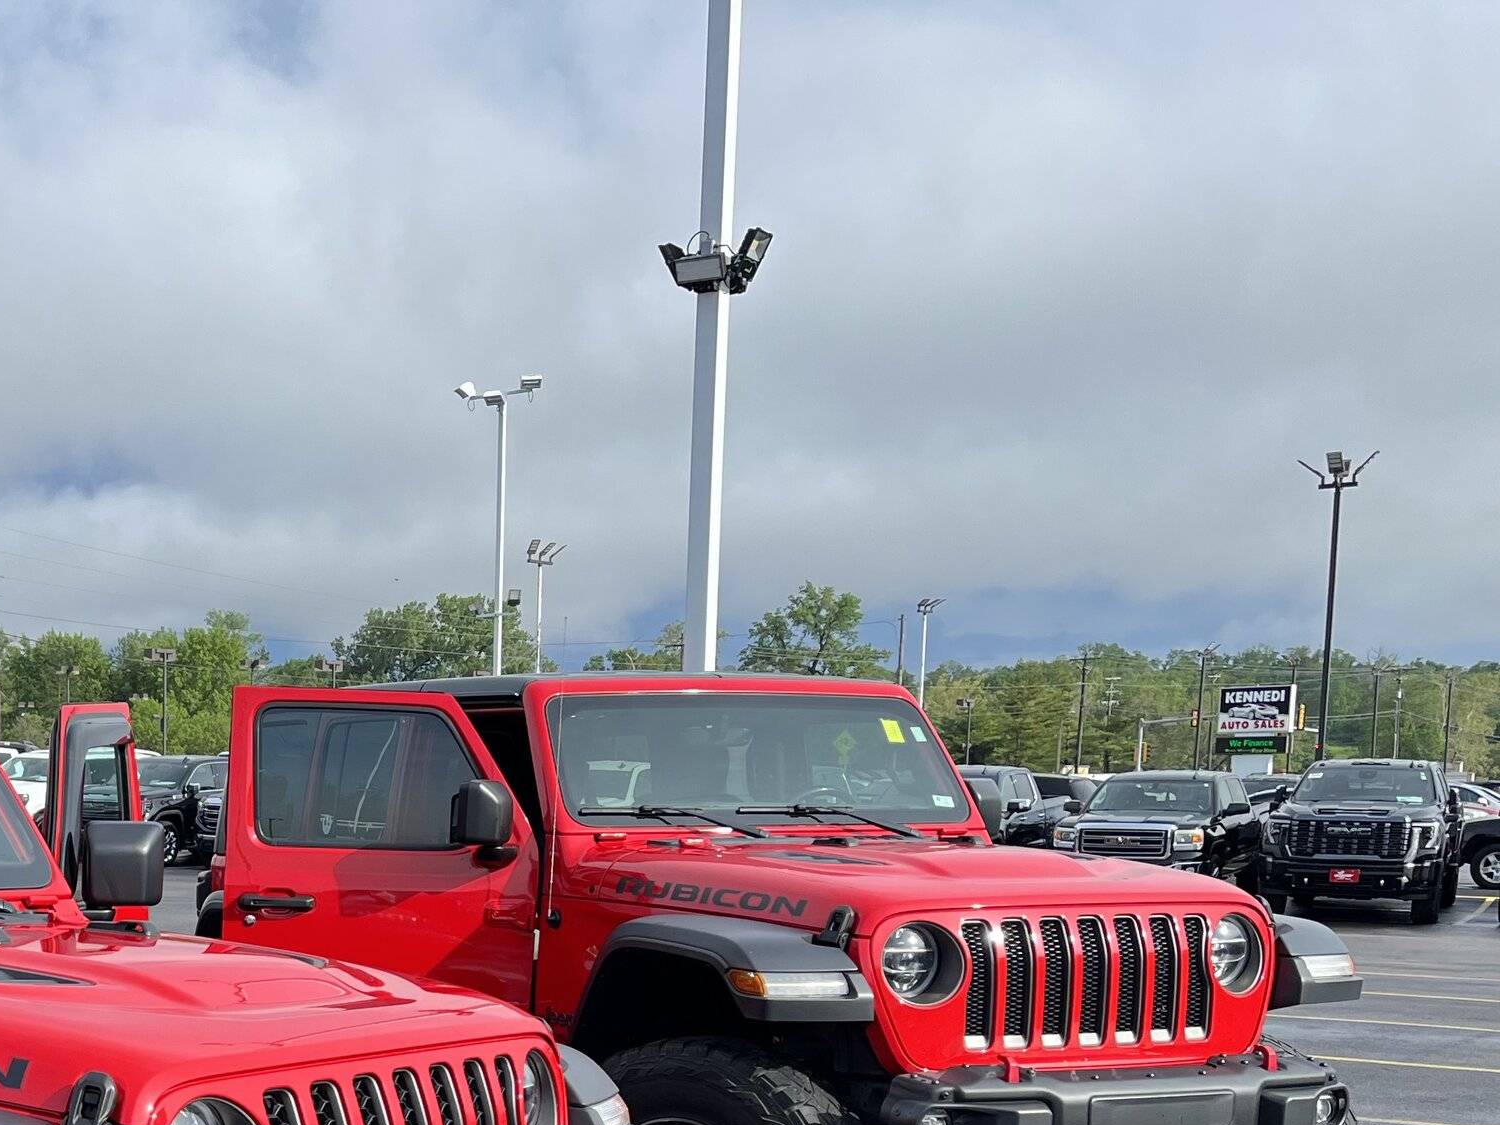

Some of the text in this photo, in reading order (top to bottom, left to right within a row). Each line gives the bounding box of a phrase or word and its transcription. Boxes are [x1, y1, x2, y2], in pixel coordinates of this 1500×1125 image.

[1225, 690, 1285, 703] KENNEDI
[1221, 720, 1284, 729] AUTO SALES
[615, 876, 809, 917] RUBICON
